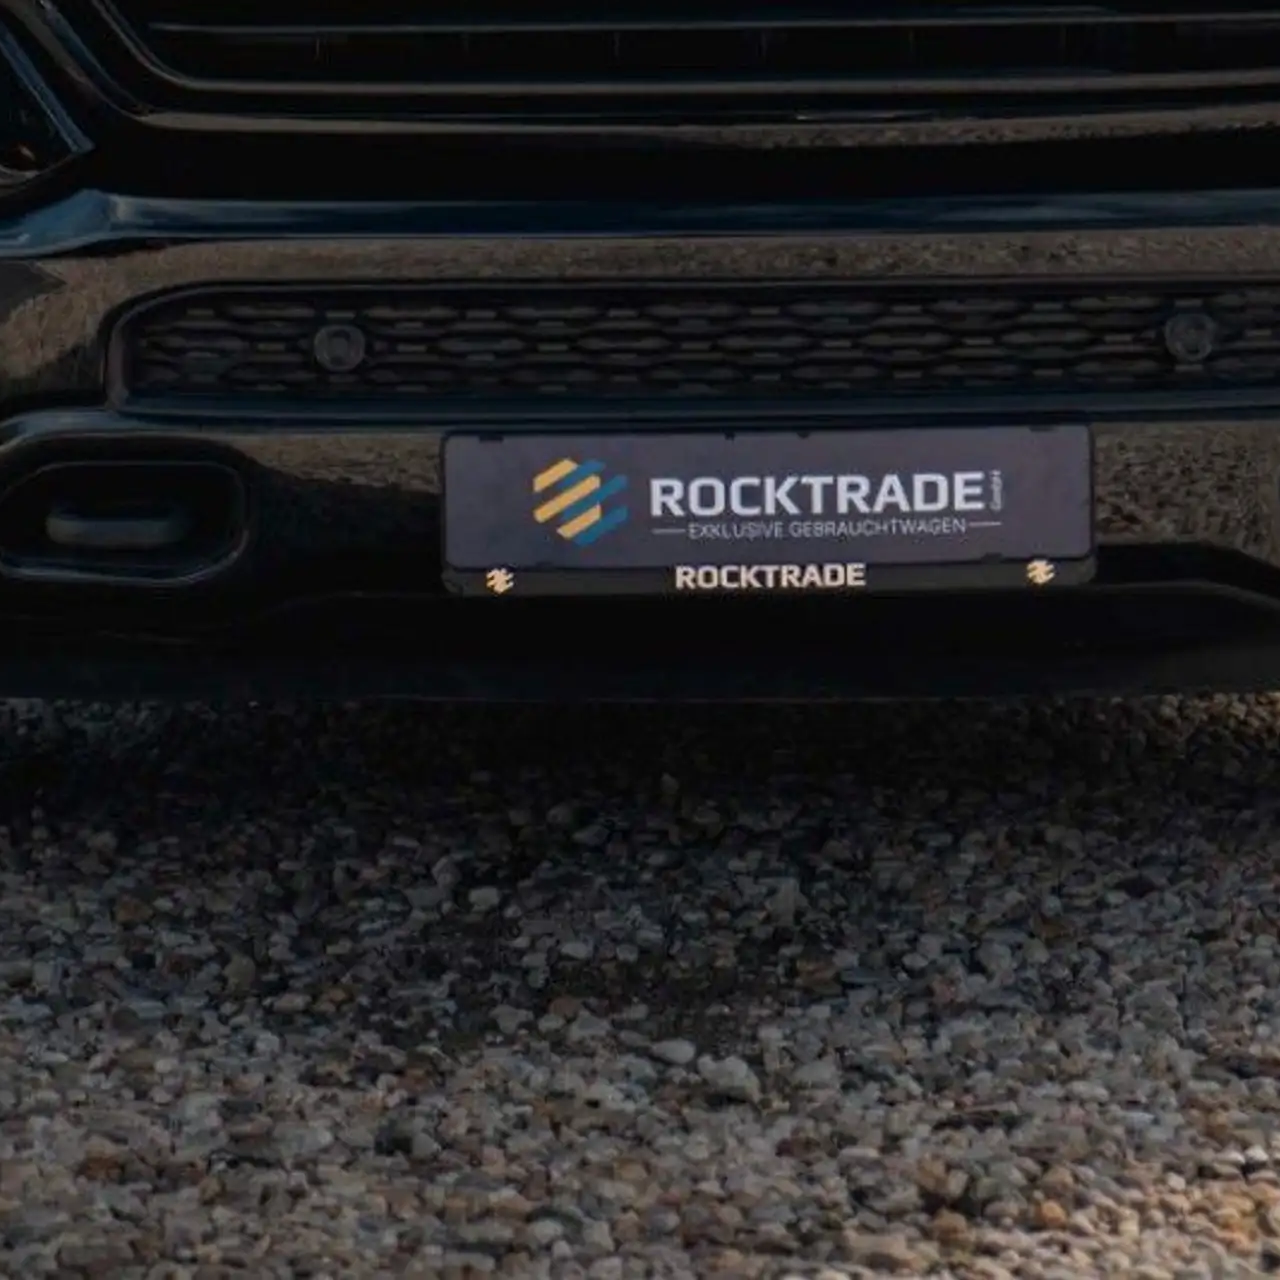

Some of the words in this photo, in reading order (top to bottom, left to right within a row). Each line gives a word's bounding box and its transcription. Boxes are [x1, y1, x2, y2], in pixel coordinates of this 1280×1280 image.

[650, 471, 985, 517] ROCKTRADE
[687, 522, 784, 540] EXKLUSIVE
[791, 517, 967, 538] GEBRAUCHTWAGEN
[675, 563, 867, 590] ROCKTRADE
